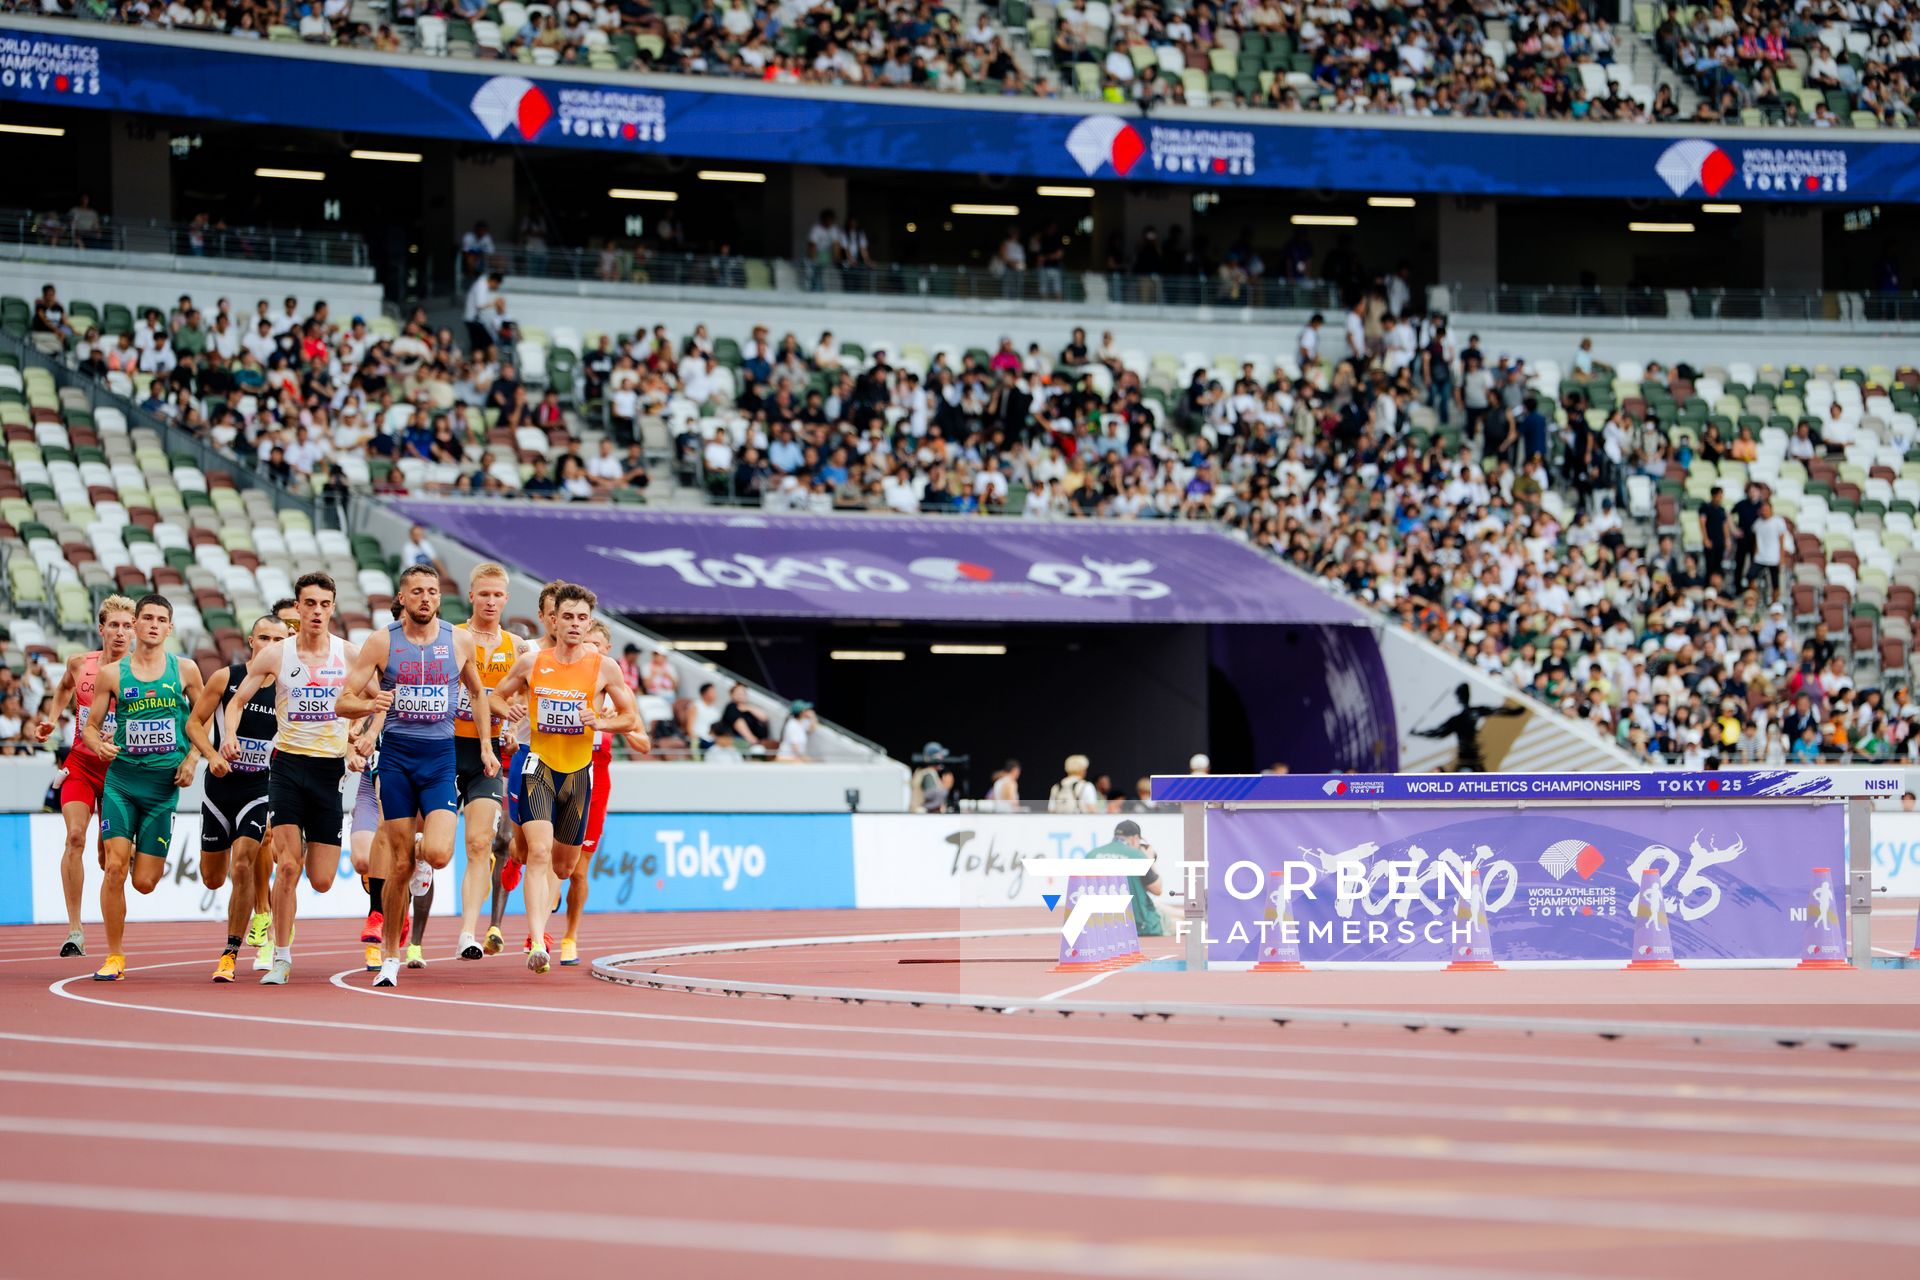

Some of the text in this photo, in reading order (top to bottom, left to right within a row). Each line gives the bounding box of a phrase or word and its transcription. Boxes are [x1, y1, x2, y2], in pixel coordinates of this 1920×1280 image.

[32, 41, 99, 62] ATHLETICS
[1026, 554, 1172, 600] 25
[399, 660, 444, 674] GREAT
[396, 673, 449, 685] BRITAIN
[302, 687, 336, 698] TDK
[410, 686, 444, 697] TDK
[128, 698, 177, 713] AUSTRALIA
[299, 700, 329, 712] SISK
[398, 699, 445, 711] GOURLEY
[550, 701, 582, 711] TDK
[546, 713, 574, 725] BEN
[141, 720, 171, 731] TDK
[129, 733, 173, 745] MYERS
[1407, 782, 1454, 793] WORLD
[1458, 781, 1528, 792] ATHLETICS
[1532, 780, 1641, 792] CHAMPIONSHIPS
[1864, 779, 1899, 790] NISHI
[655, 830, 766, 890] Tokyo
[1528, 888, 1616, 896] WORLD ATHLETICS
[1528, 896, 1616, 906] CHAMPIONSHIPS
